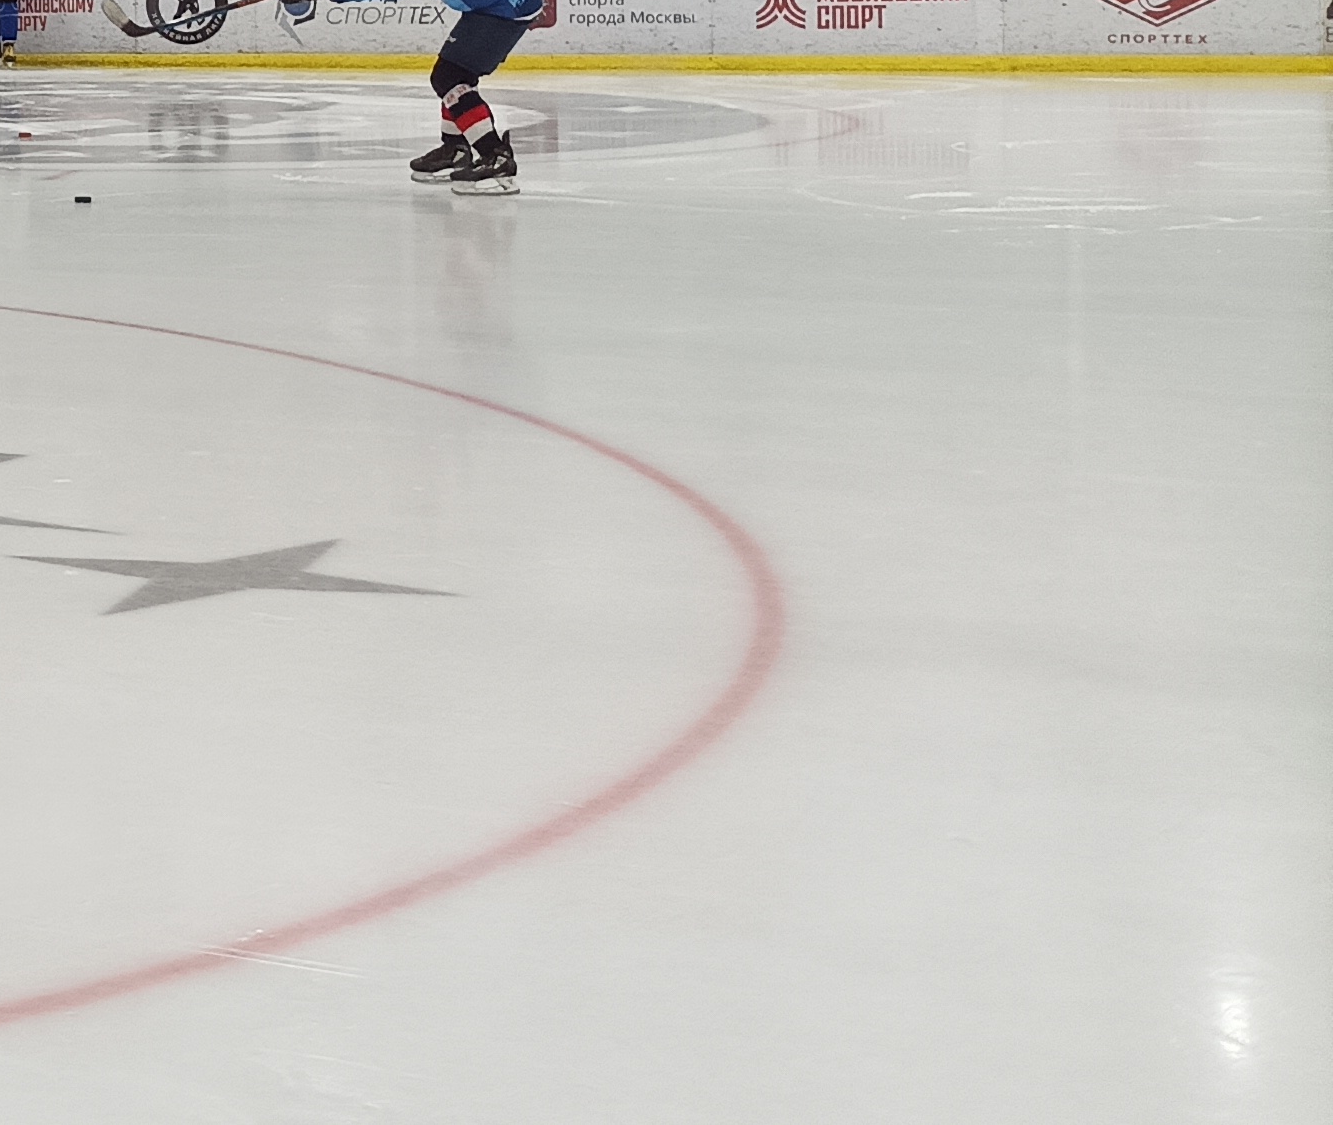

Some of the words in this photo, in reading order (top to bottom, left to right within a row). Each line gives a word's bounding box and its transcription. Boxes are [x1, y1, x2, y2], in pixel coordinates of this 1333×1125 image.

[17, 15, 47, 31] ОРТУ
[326, 6, 447, 25] СПОРТТЕХ
[569, 13, 625, 27] города
[630, 11, 697, 24] Москвы
[817, 5, 886, 29] СПОРТ
[151, 13, 202, 41] ХОКЕЙНАЯ
[1107, 34, 1208, 44] СПОРТТЕХ
